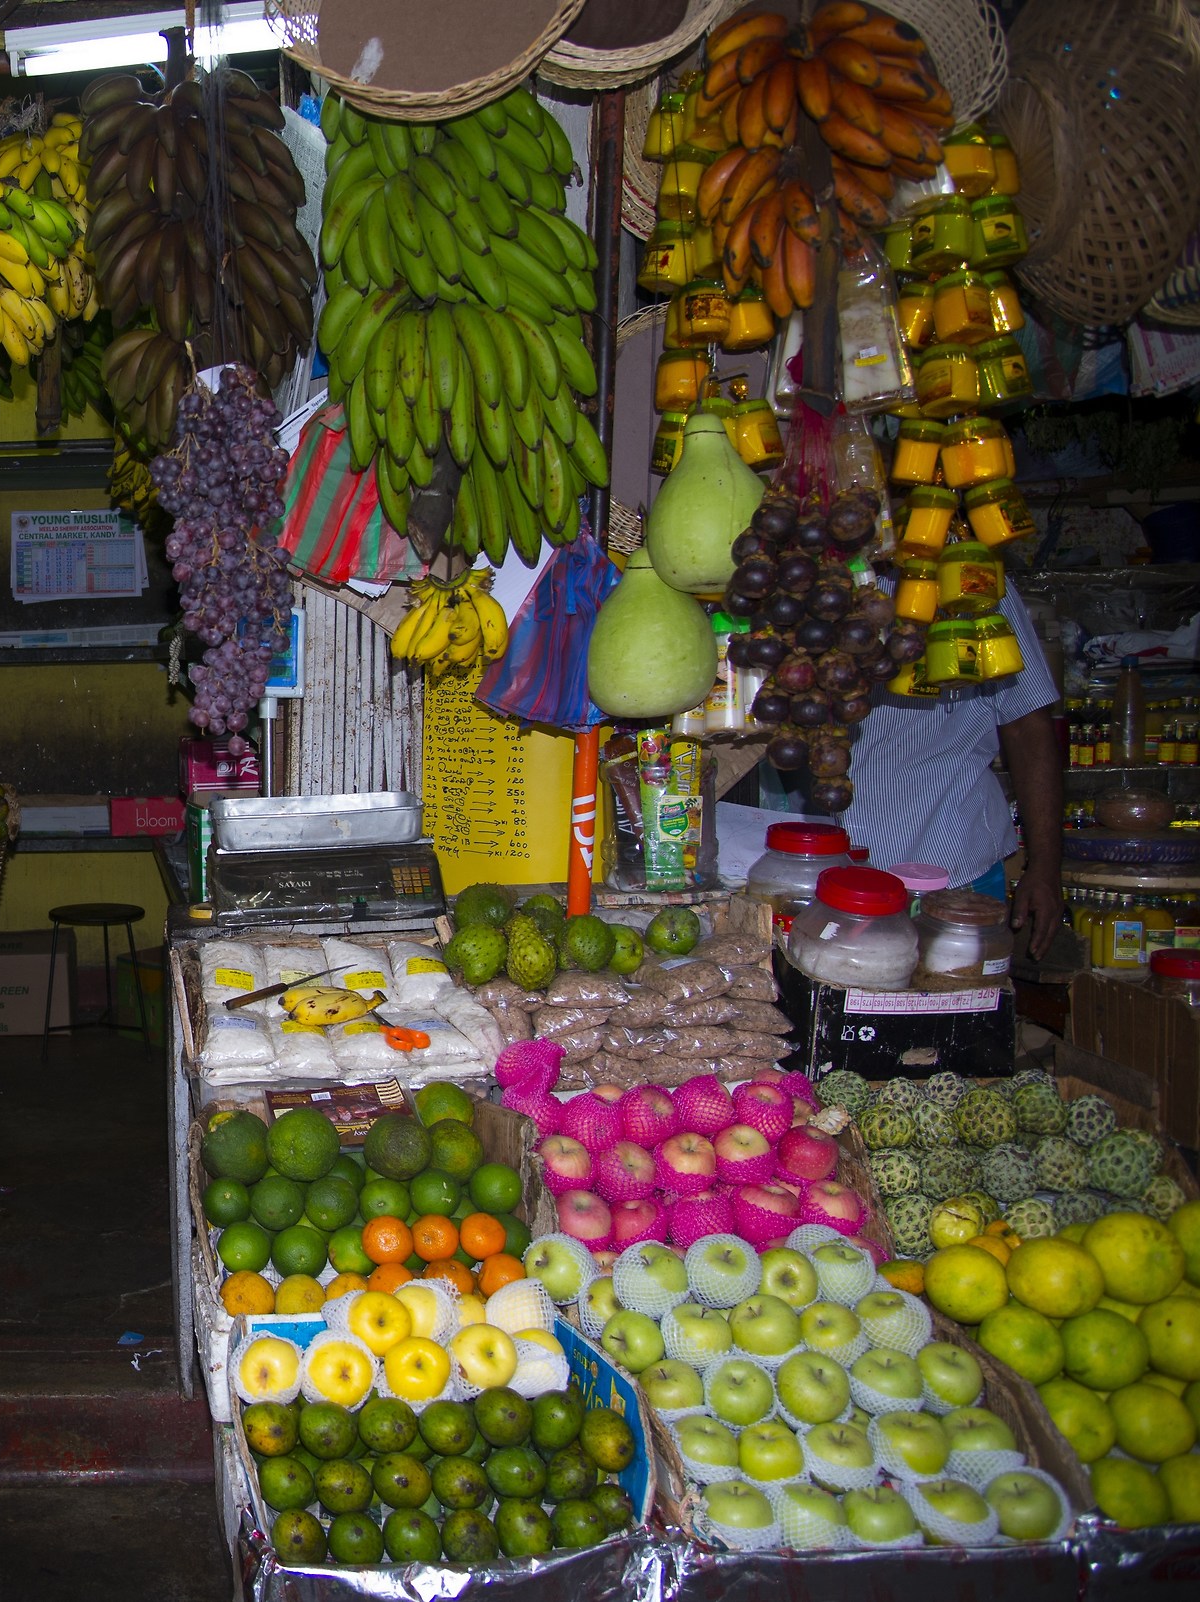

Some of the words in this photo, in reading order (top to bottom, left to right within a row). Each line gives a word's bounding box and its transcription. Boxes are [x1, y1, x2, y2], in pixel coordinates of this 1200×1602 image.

[31, 515, 70, 525] YOUNG
[73, 514, 118, 524] MUSLIM
[18, 532, 54, 540] CENTRAL
[90, 531, 116, 539] KANDY
[506, 788, 525, 796] 350
[136, 808, 178, 827] bloom
[513, 817, 527, 826] 80
[425, 821, 436, 830] 27
[514, 829, 526, 837] 60
[509, 840, 528, 848] 600
[505, 850, 530, 858] 1200
[278, 880, 312, 889] SAYAKI
[977, 989, 995, 999] SIZE
